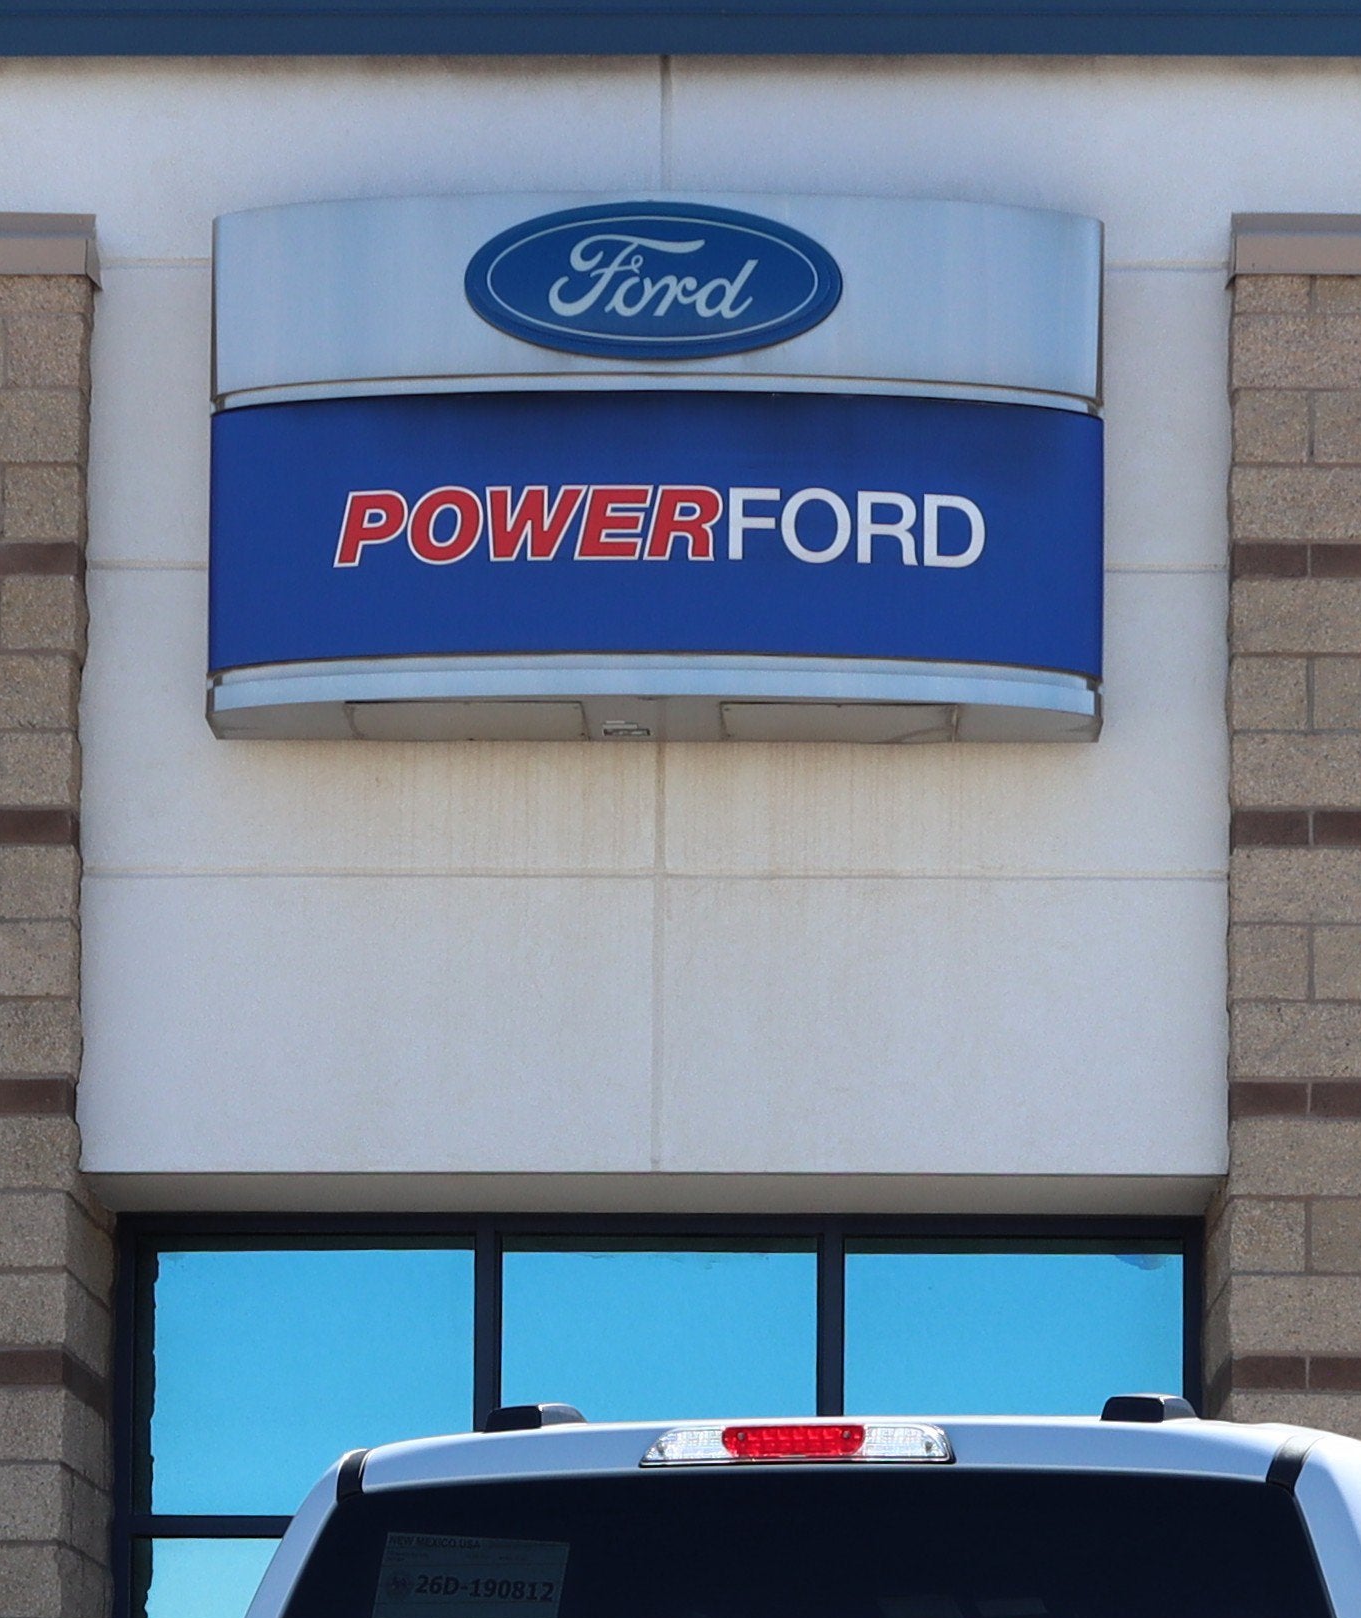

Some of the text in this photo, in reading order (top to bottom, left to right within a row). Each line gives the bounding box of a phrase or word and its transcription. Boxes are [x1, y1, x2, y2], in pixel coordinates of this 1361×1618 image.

[548, 233, 759, 320] Ford
[333, 485, 987, 568] POWERFORD
[388, 1536, 481, 1549] NEW MEXICO USA
[414, 1574, 555, 1602] 26D-190812
